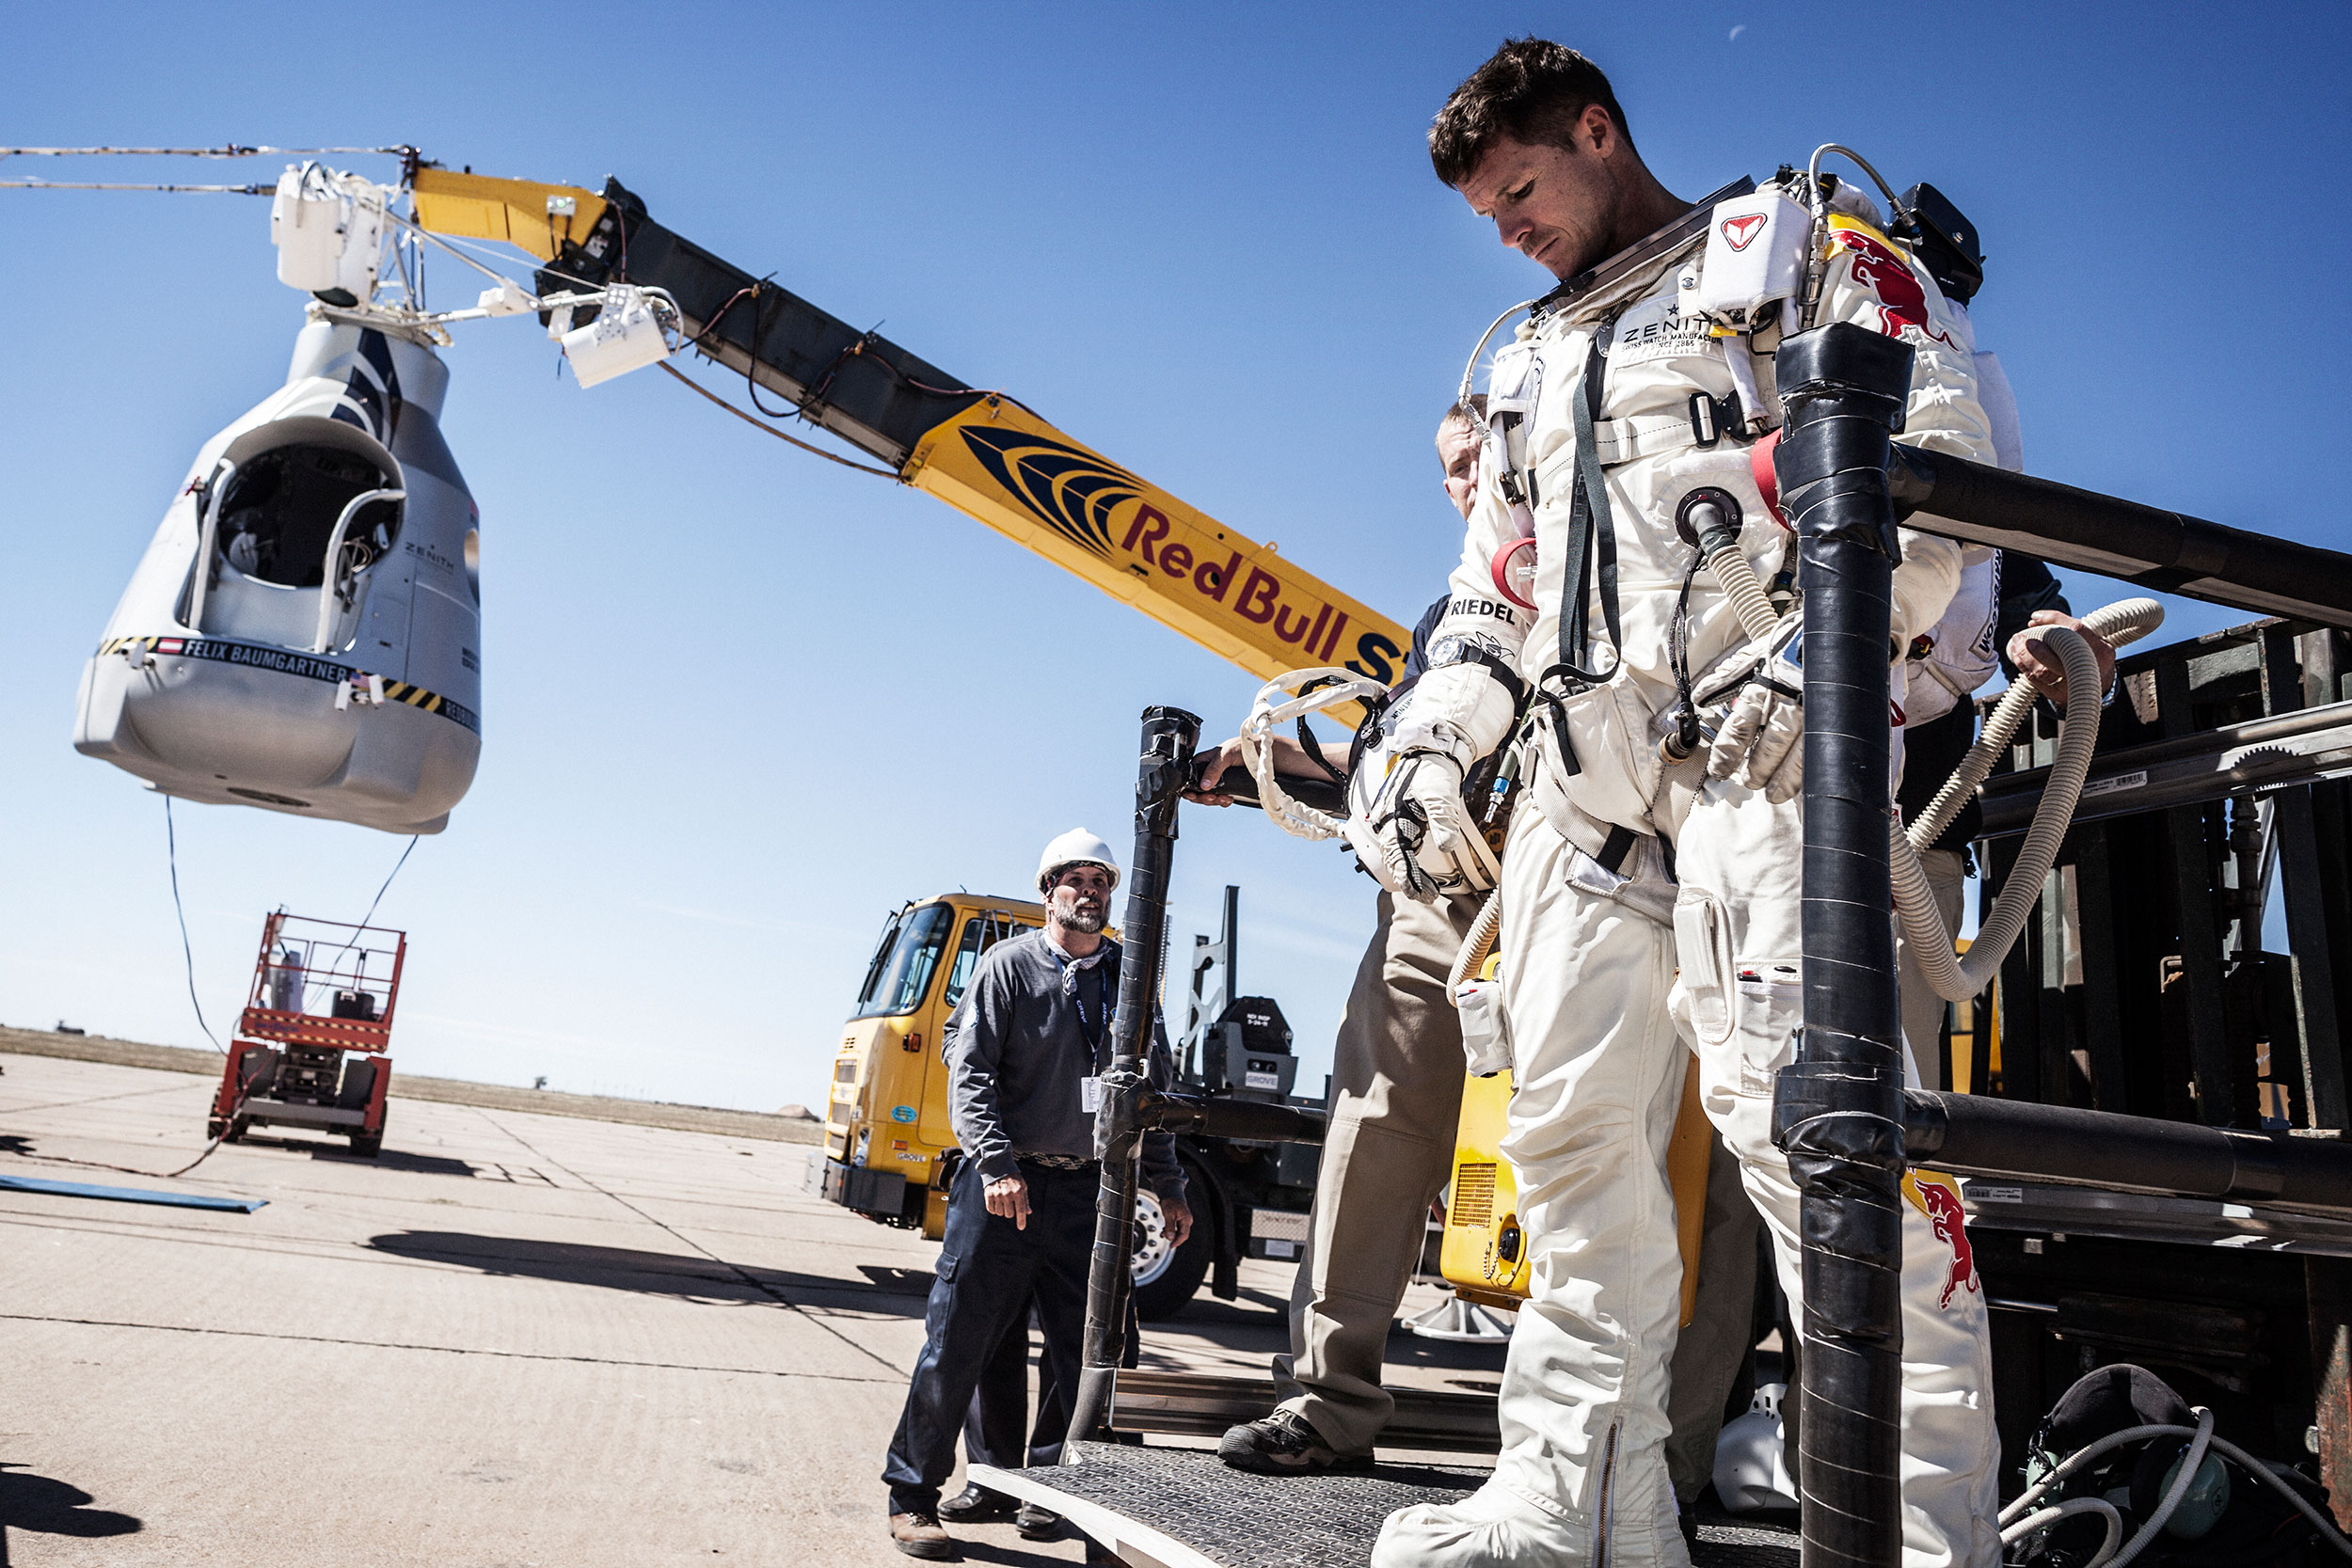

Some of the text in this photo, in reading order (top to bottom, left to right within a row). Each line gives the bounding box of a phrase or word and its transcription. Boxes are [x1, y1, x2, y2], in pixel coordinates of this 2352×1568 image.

[1624, 318, 1708, 343] ZENIT
[1643, 335, 1667, 345] WATCH
[1451, 598, 1515, 626] RIEDEL
[184, 641, 348, 681] FELIX BAUMGARTNER
[1344, 632, 1411, 688] S
[1076, 1000, 1088, 1023] CREW
[1247, 1075, 1277, 1085] GROVE
[897, 1152, 926, 1163] GROVE
